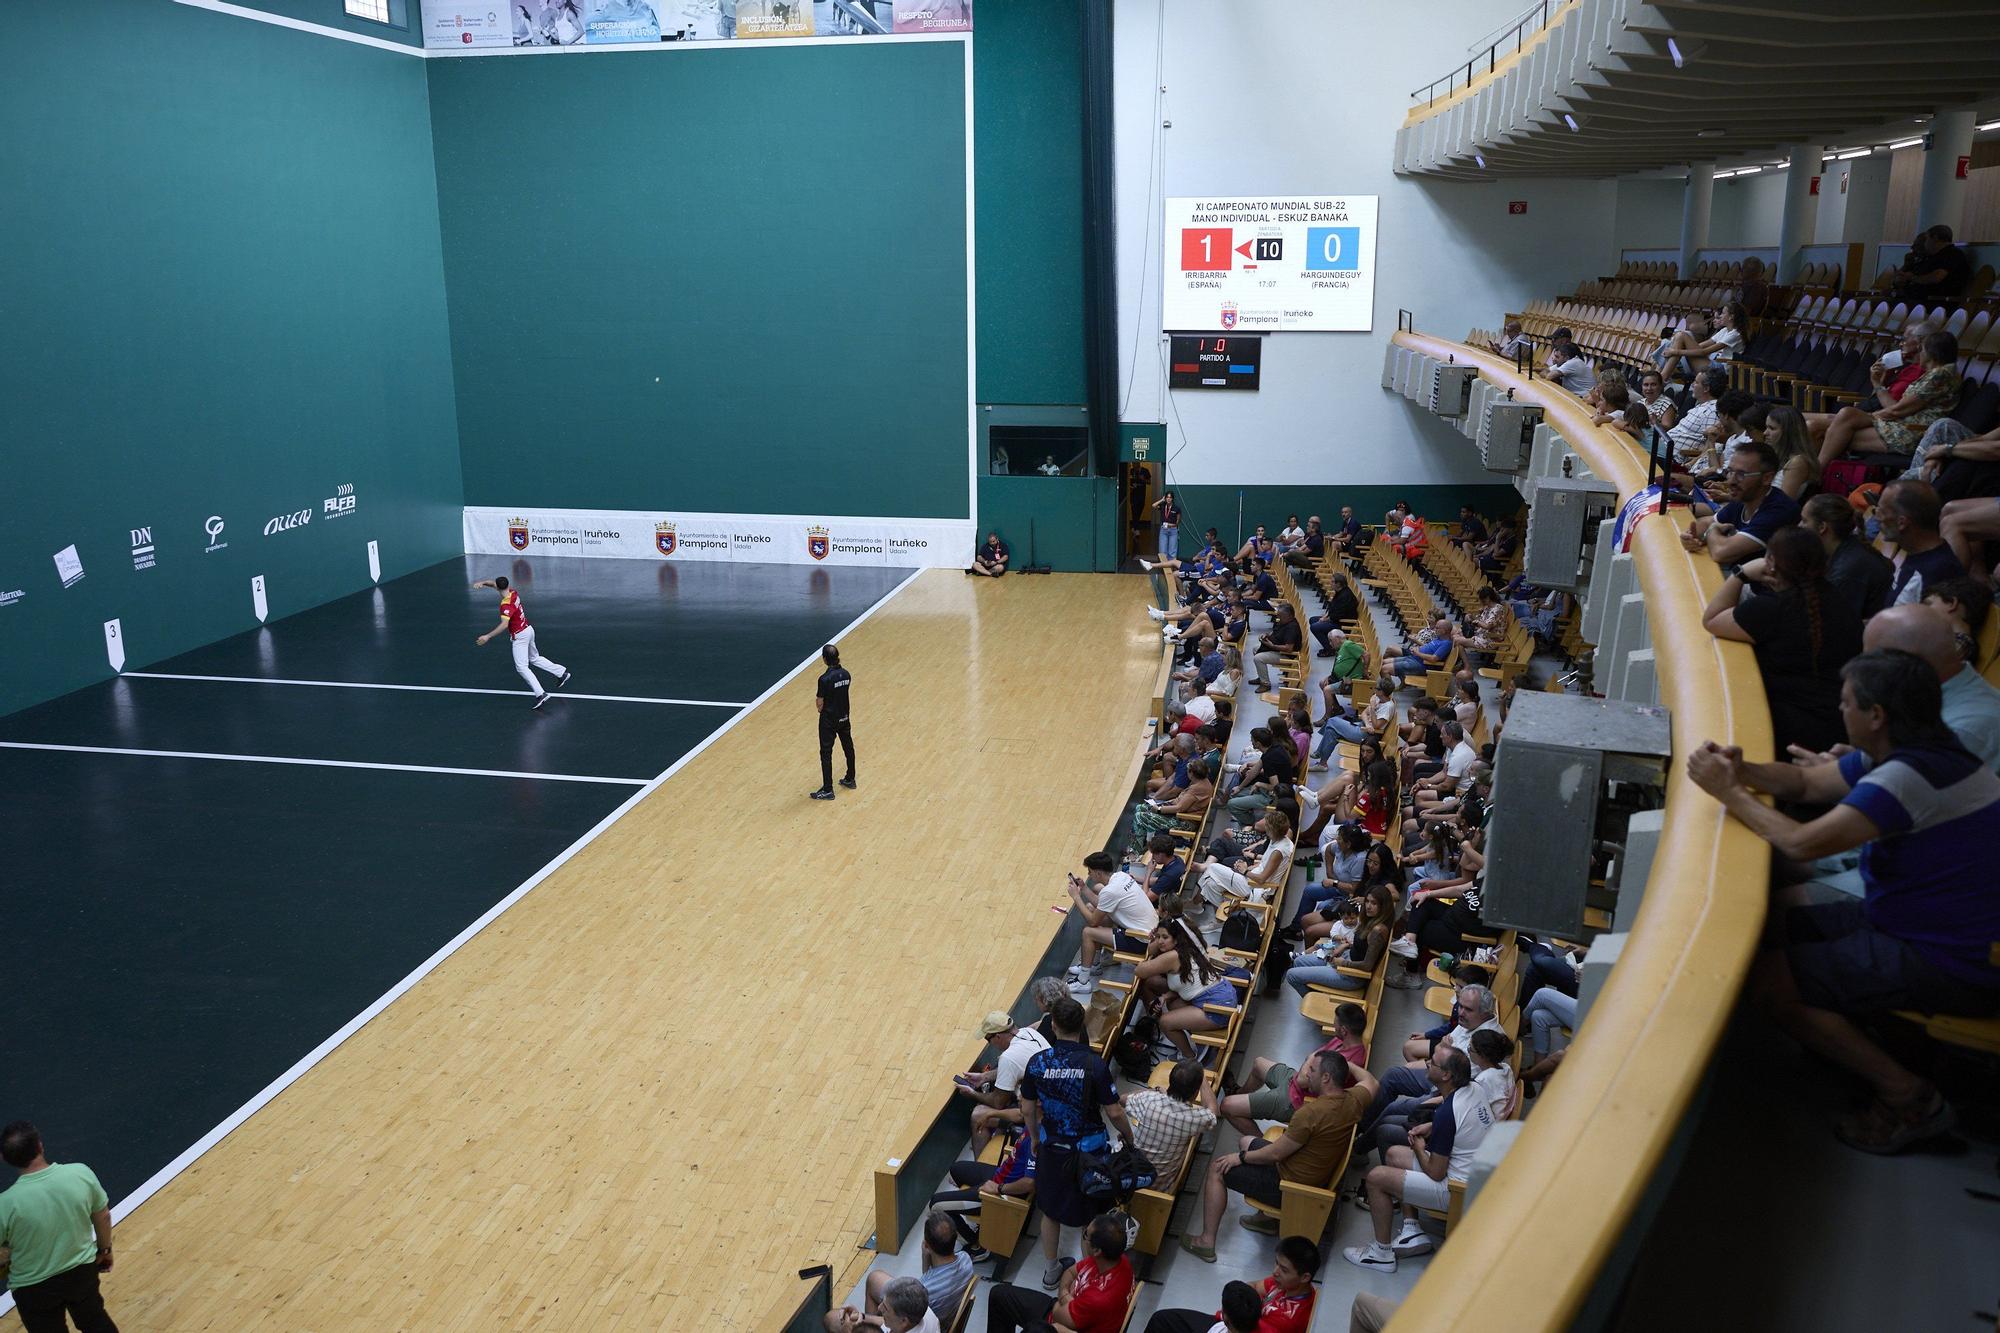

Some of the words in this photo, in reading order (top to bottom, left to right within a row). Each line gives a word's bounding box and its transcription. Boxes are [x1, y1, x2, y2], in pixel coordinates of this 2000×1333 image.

[1195, 202, 1204, 211] XI
[1206, 202, 1268, 211] CAMPEONATO
[1270, 201, 1311, 210] MUNDIAL
[1313, 201, 1346, 210] SUB-22
[1191, 214, 1218, 223] MANO
[1220, 213, 1270, 222] INDIVIDUAL
[1278, 213, 1308, 222] ESKUZ
[1310, 213, 1348, 222] BANAKA
[1200, 233, 1212, 263] 1
[1260, 241, 1280, 258] 10
[1323, 233, 1341, 263] 0
[1185, 271, 1227, 279] IRRIBARRIA
[1300, 271, 1362, 279] HARGUINDEGUY
[1311, 280, 1350, 289] (FRANCIA)
[1239, 315, 1279, 325] Pamplona
[1199, 354, 1224, 362] PARTIDO
[323, 495, 356, 513] ALFA
[129, 526, 152, 547] DN
[584, 529, 620, 539] Iruñeko
[734, 533, 771, 543] Iruñeko
[531, 534, 579, 546] Pamplona
[680, 539, 728, 551] Pamplona
[889, 538, 928, 548] Iruñeko
[832, 543, 882, 555] Pamplona
[256, 580, 262, 592] 2
[110, 624, 117, 639] 3
